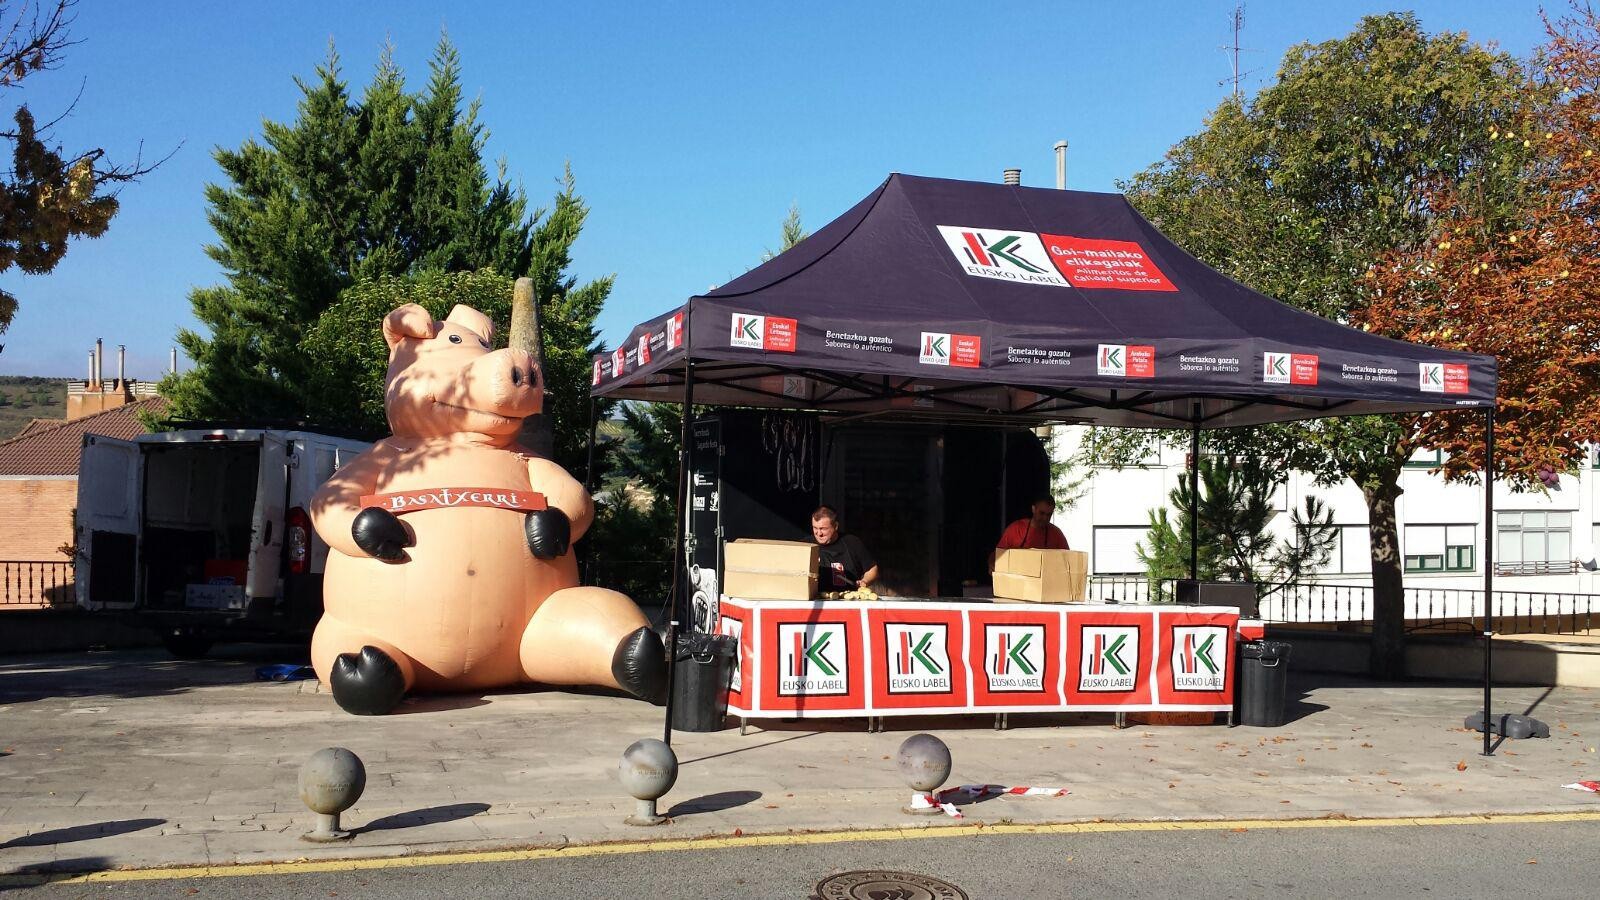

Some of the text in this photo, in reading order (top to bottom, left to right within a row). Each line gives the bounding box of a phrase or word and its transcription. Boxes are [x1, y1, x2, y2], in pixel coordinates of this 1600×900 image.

[1051, 245, 1143, 259] Goi-mailako
[1066, 258, 1144, 268] elikagaiak
[967, 266, 1066, 284] EUSKO LABEL
[1076, 268, 1132, 276] Alimentos
[826, 330, 893, 345] Benetazkoa gozatu
[825, 339, 892, 353] Saborea lo auténtico
[1008, 346, 1071, 358] Benetazkoa gozatu
[1008, 355, 1031, 363] Saborea
[1033, 356, 1040, 364] lo
[1180, 355, 1216, 364] Benetazkoa
[1180, 363, 1203, 371] Saborea
[1204, 364, 1211, 372] lo
[1342, 364, 1377, 374] Benetazkoa
[782, 680, 845, 690] EUSKO LABEL
[892, 678, 948, 688] EUSKO LABEL
[991, 678, 1041, 688] EUSKO LABEL
[1082, 678, 1133, 688] EUSKO LABEL
[1176, 677, 1203, 686] EUSKO
